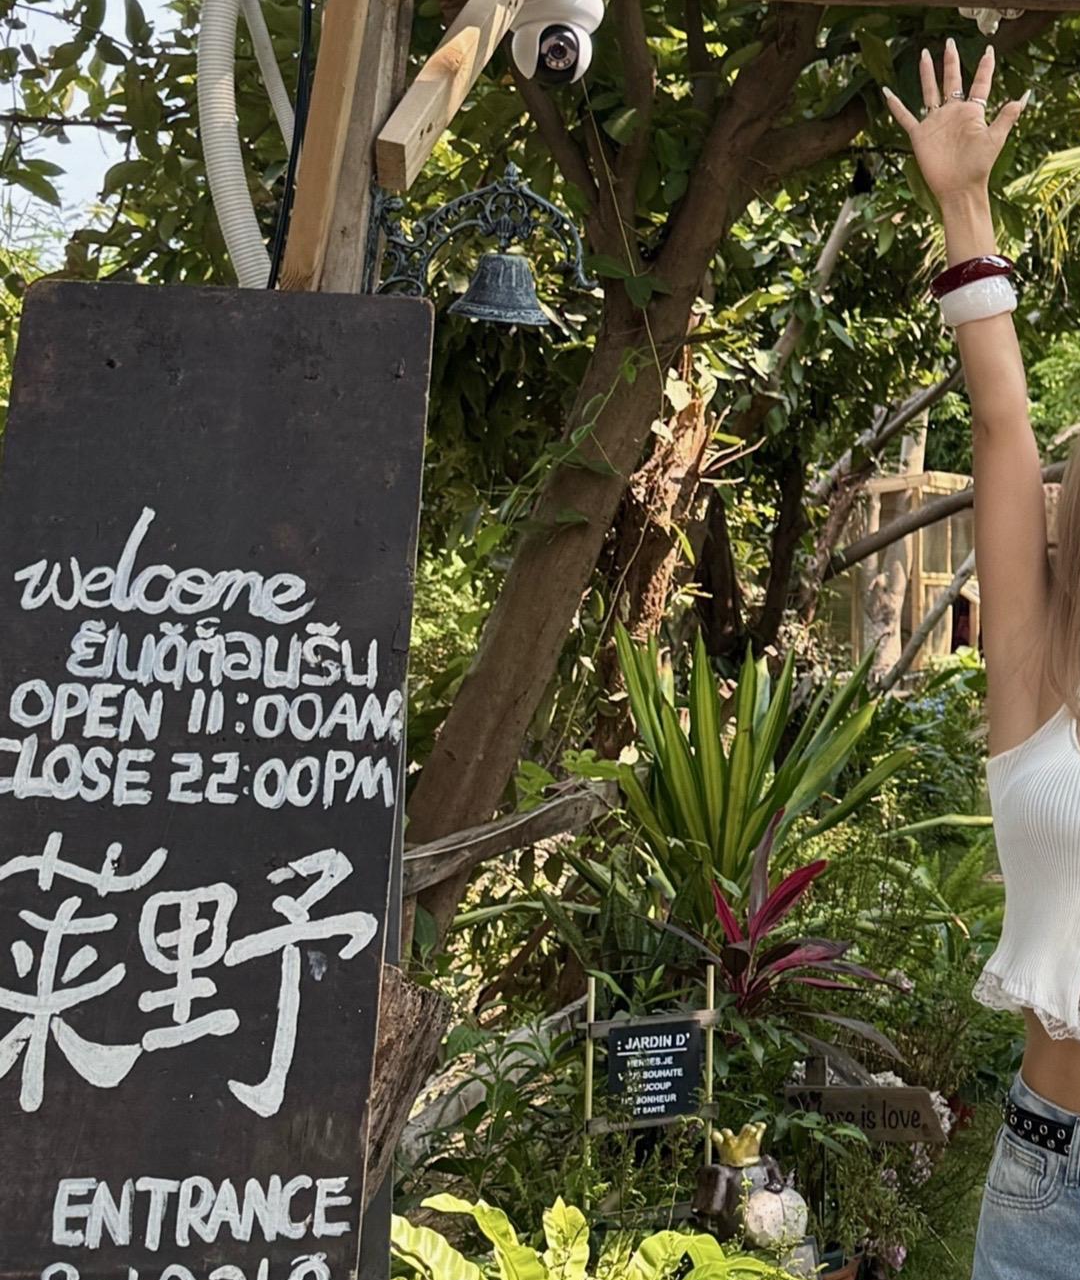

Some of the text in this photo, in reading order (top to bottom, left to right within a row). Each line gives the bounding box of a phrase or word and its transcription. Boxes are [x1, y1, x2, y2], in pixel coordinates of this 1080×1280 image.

[14, 506, 316, 624] welcome
[9, 679, 403, 745] OPEN 11:00AM
[168, 749, 394, 810] 22:00PM
[625, 1034, 672, 1050] JARDIN
[643, 1068, 683, 1079] SOUHAITE
[862, 1104, 876, 1129] is
[52, 1175, 352, 1251] ENTRANCE
